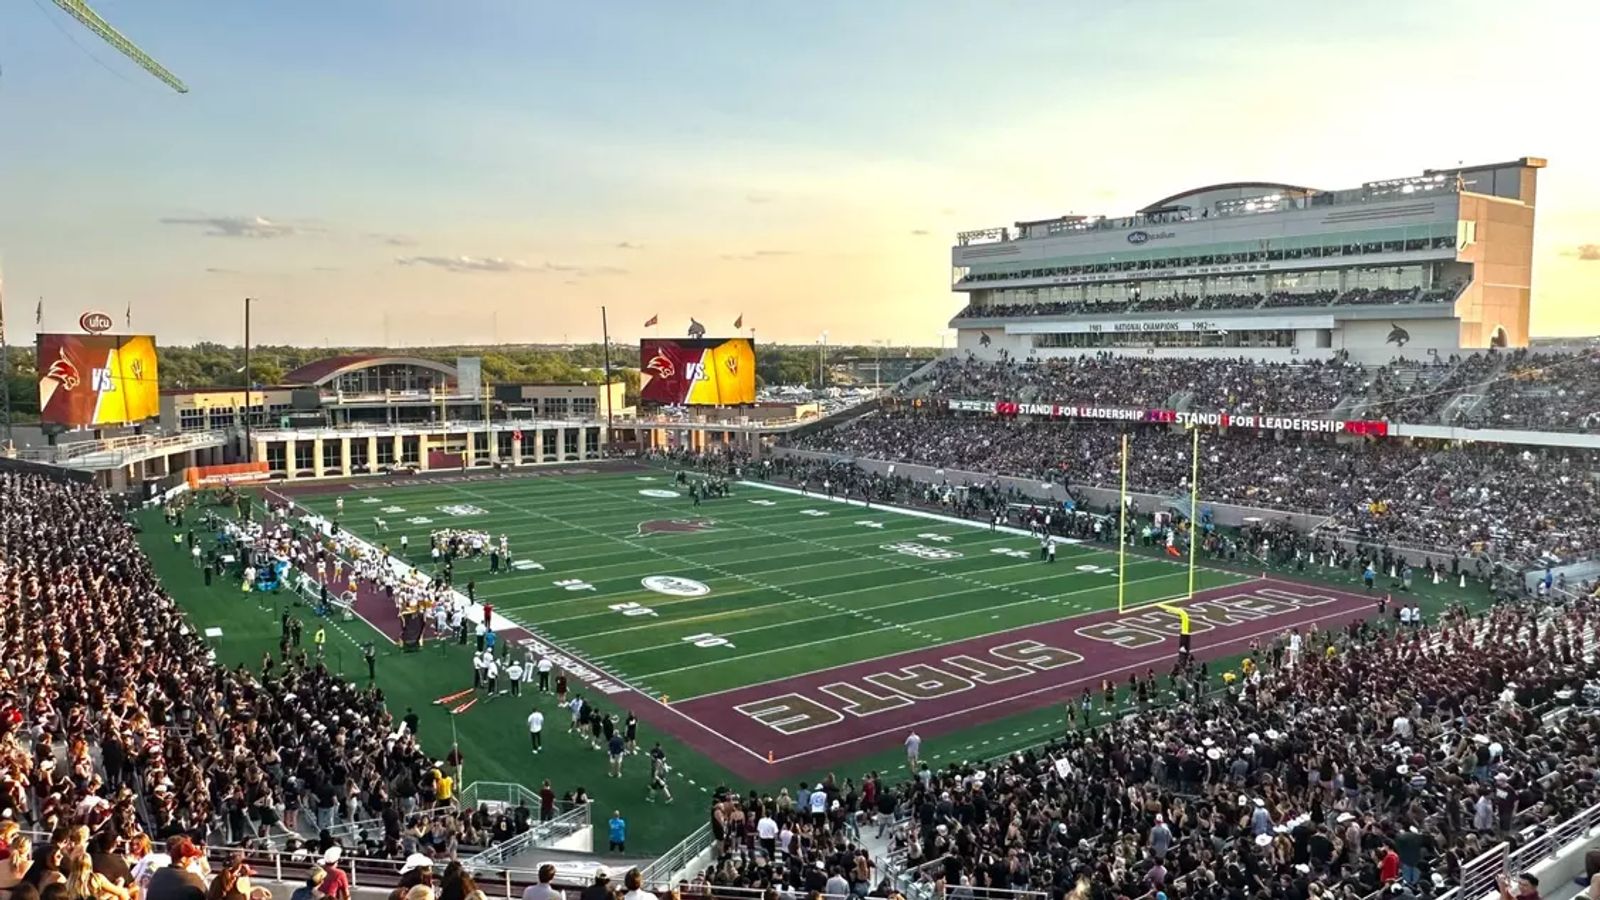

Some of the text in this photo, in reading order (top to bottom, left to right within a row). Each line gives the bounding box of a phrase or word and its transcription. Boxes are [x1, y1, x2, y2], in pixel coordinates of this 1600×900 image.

[89, 316, 110, 328] ufcu
[1114, 323, 1140, 332] NATIONAL
[1142, 321, 1179, 330] CHAMPIONS
[685, 362, 708, 380] VS.
[92, 368, 116, 391] VS.
[1058, 407, 1077, 417] FOR
[1081, 408, 1144, 421] LEADERSHIP
[1229, 415, 1254, 427] FOR
[1259, 417, 1345, 433] LEADERSHIP
[608, 601, 653, 616] 20
[681, 632, 728, 648] 10
[732, 588, 1336, 736] TEXAS STATE
